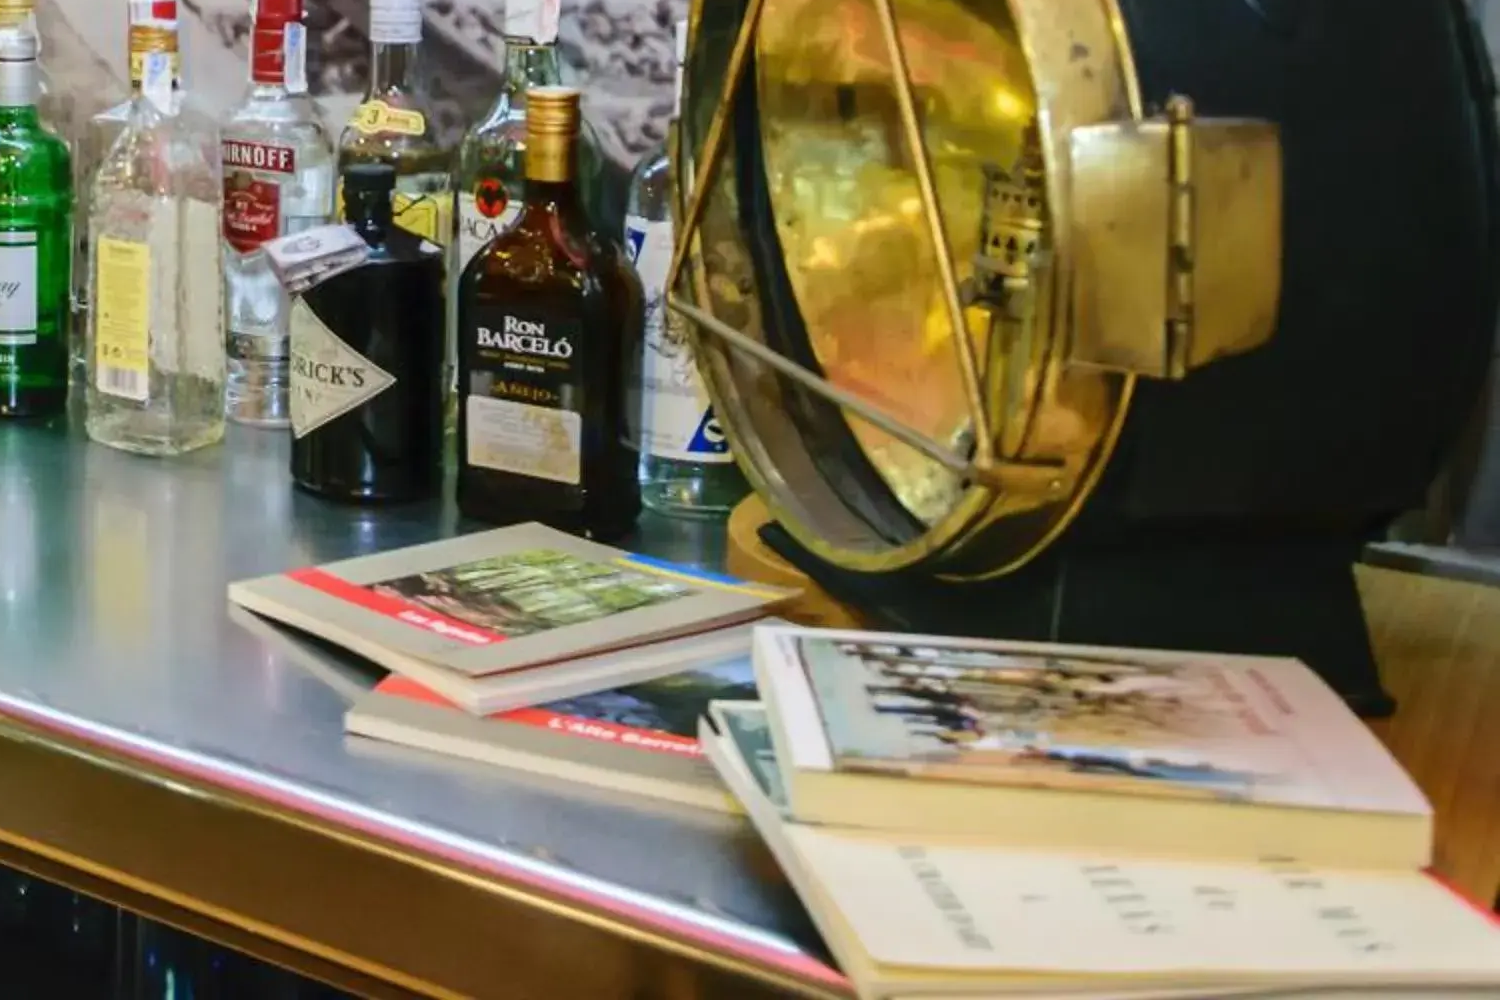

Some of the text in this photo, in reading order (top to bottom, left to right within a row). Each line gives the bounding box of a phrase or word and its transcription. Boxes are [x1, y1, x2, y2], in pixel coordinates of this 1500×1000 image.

[227, 144, 289, 169] IRNOFF
[504, 315, 545, 336] RON
[477, 327, 573, 358] BARCELÓ
[292, 356, 366, 388] RICK'S
